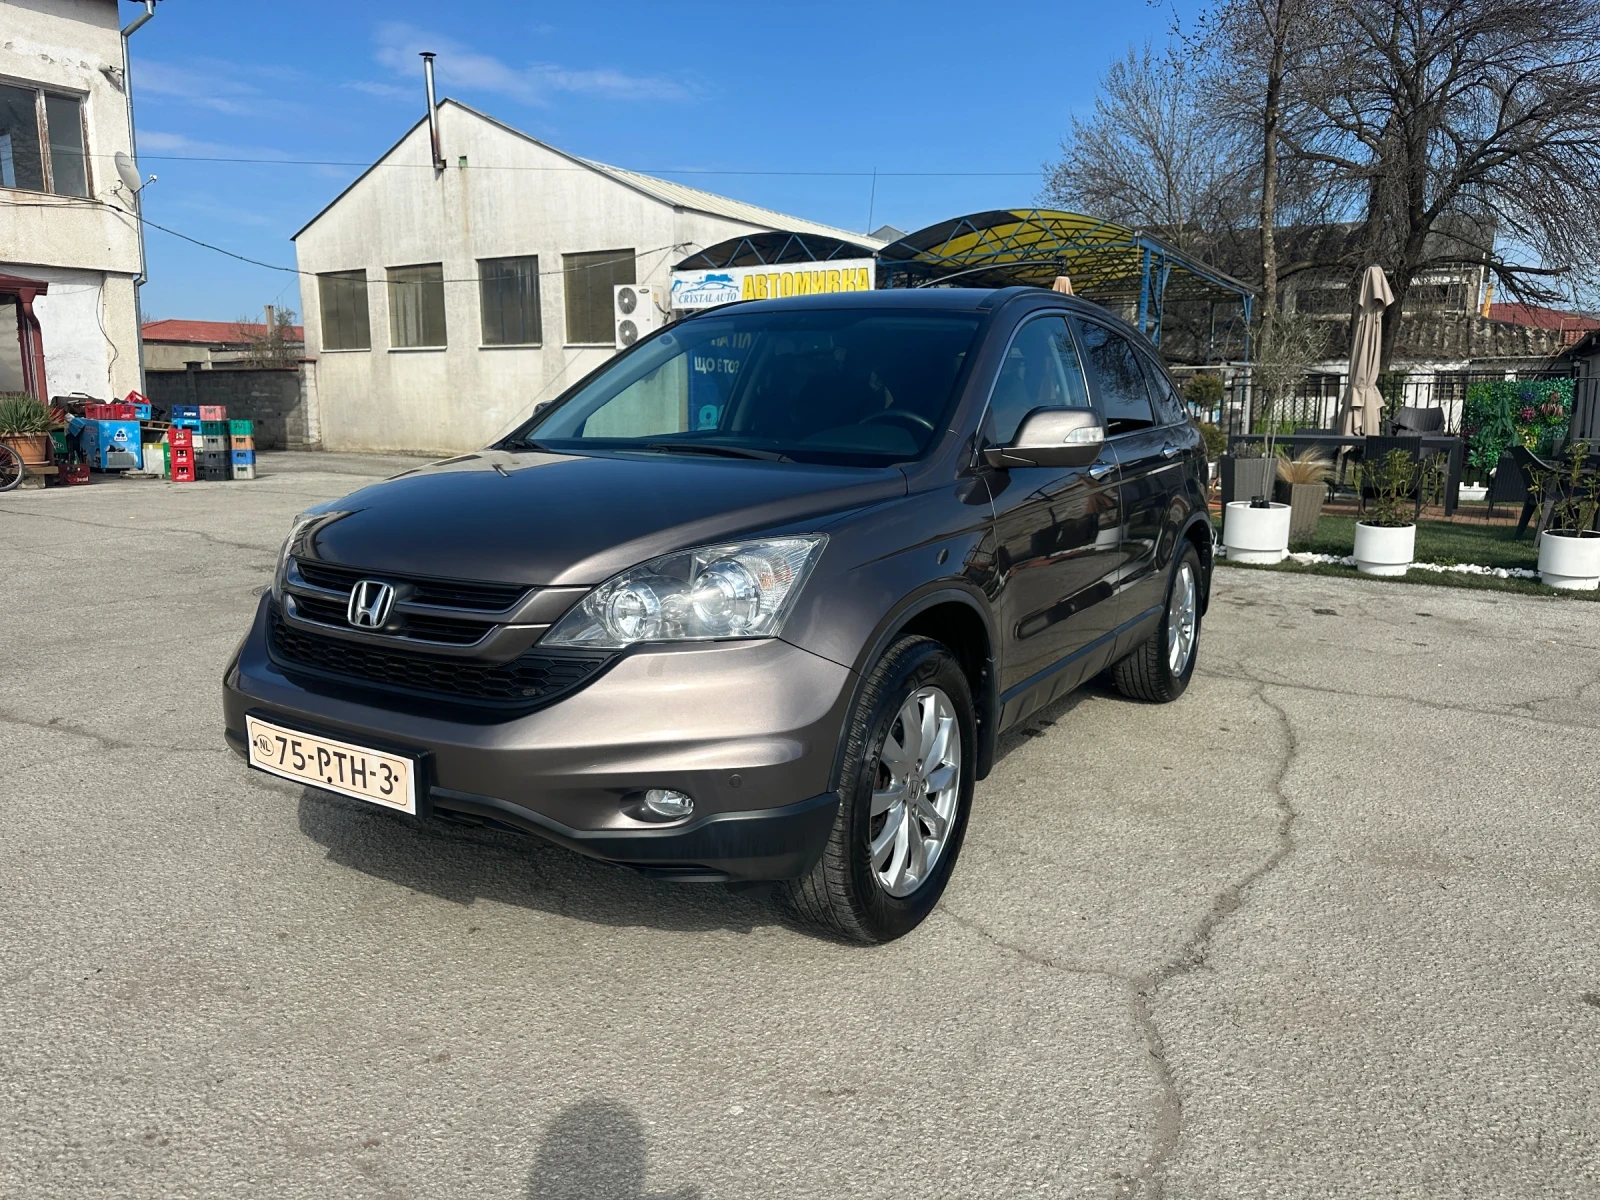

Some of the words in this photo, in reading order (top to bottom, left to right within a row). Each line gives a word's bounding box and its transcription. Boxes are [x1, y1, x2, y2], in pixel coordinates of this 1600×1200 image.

[741, 268, 870, 301] АВТОМИВКА
[678, 293, 713, 304] CRYSTAL
[714, 292, 737, 302] AUTO
[694, 356, 715, 375] ЩО
[258, 739, 272, 753] NL
[275, 735, 394, 796] 75-PTH-3
